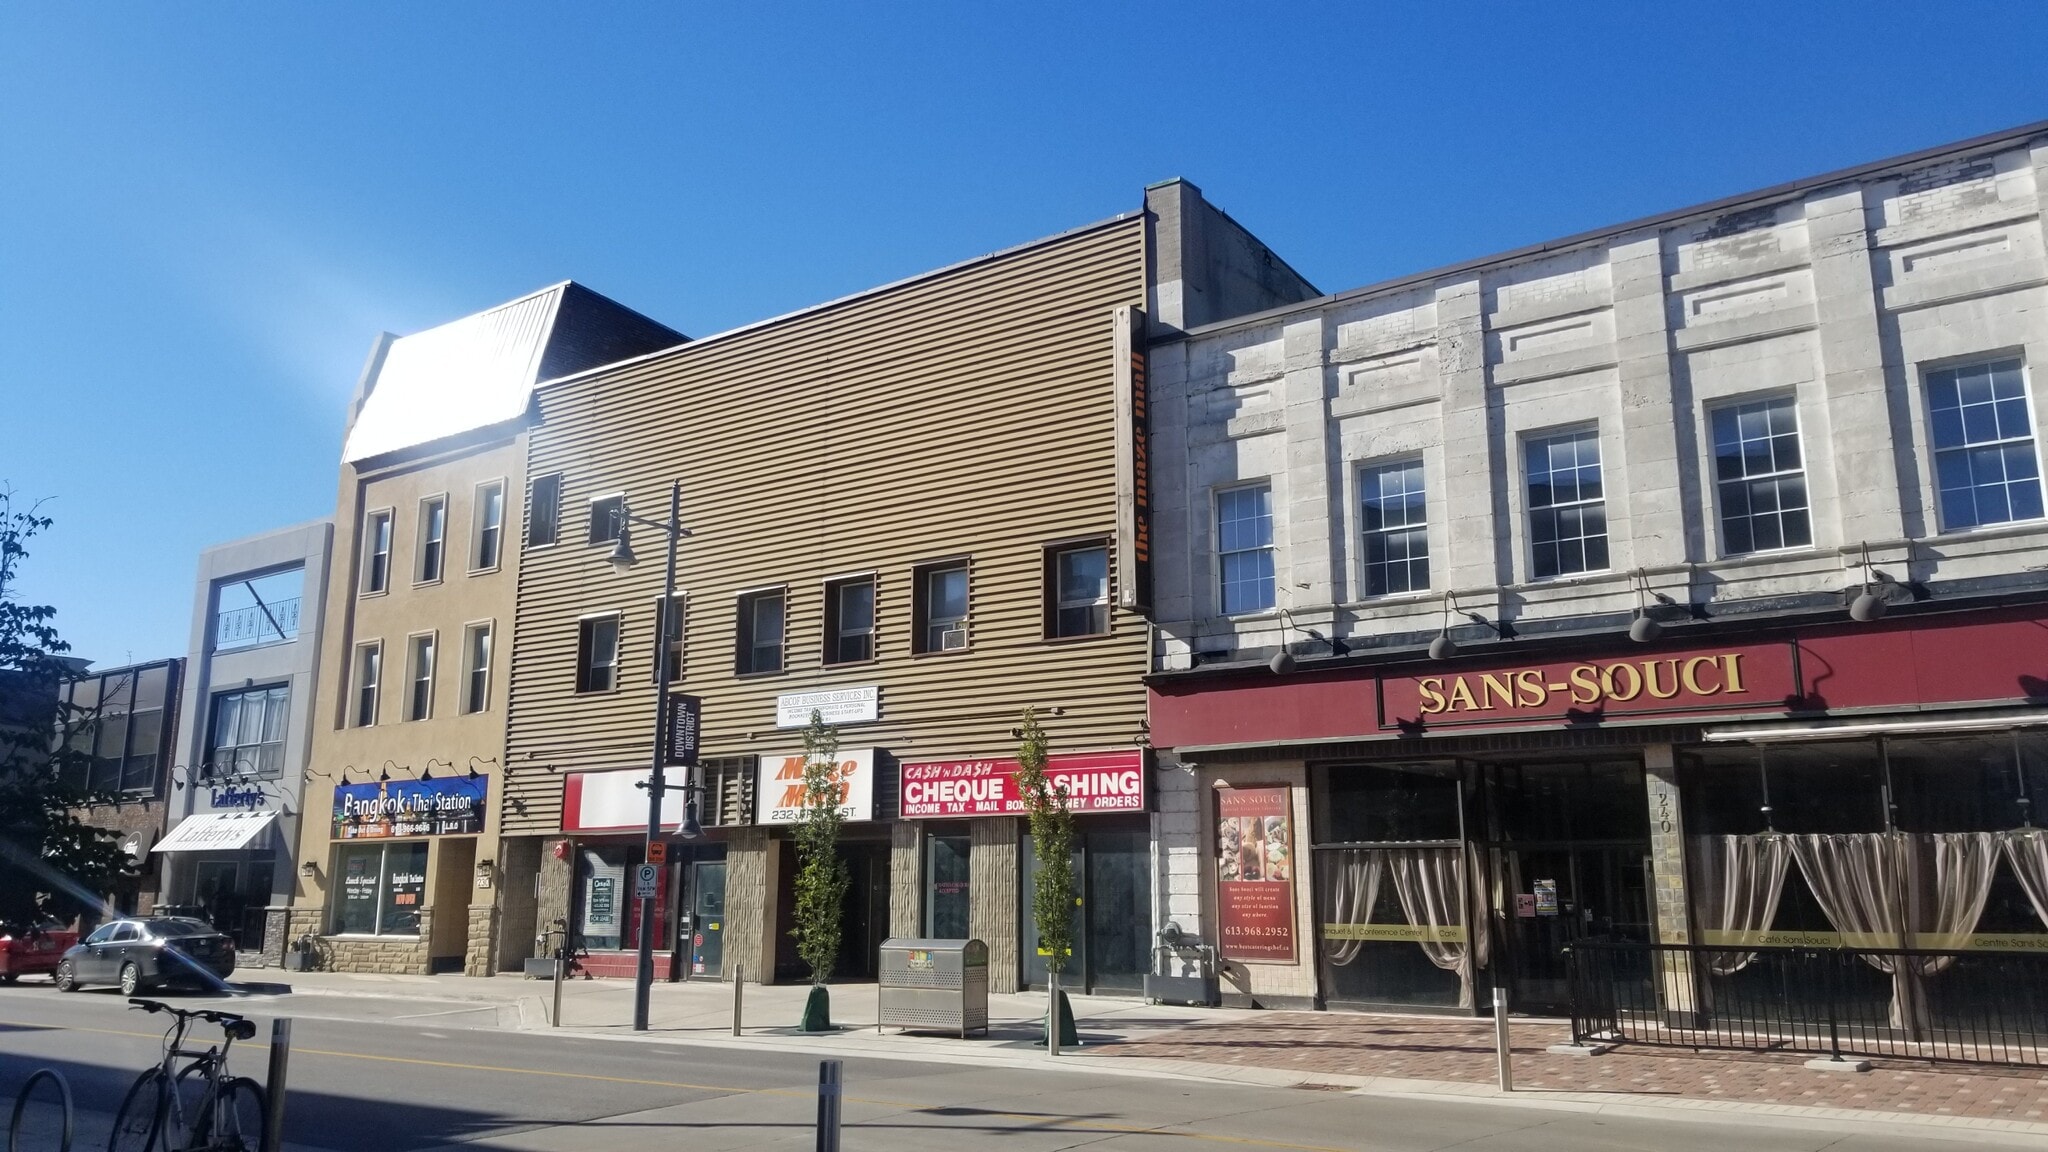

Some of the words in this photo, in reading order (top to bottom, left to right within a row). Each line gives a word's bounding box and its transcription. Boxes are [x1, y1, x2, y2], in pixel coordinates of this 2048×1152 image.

[1131, 351, 1145, 418] mall
[1136, 426, 1147, 507] maze
[1135, 515, 1148, 562] the
[1418, 652, 1747, 715] SANS-SOUCI
[674, 702, 687, 758] DOWNTOWN
[685, 711, 695, 750] DISTRICT
[211, 785, 265, 812] Lafferty's
[904, 778, 1004, 804] CHEQUE
[1221, 795, 1246, 805] SANS
[1248, 794, 1282, 804] SOUCI
[344, 789, 405, 823] Bangkok
[412, 793, 434, 812] Thai
[435, 791, 471, 811] Station
[771, 809, 794, 820] 232
[905, 802, 940, 814] INCOME
[946, 801, 965, 813] TAX
[976, 800, 999, 812] MAIL
[1093, 795, 1139, 808] ORDERS
[1225, 926, 1289, 936] 613.968.2952
[1358, 927, 1398, 937] Conference
[1399, 928, 1423, 937] Center
[1782, 935, 1804, 944] Sans
[1805, 936, 1831, 945] Souci
[1974, 937, 2008, 947] Centre
[2011, 938, 2035, 947] Sans
